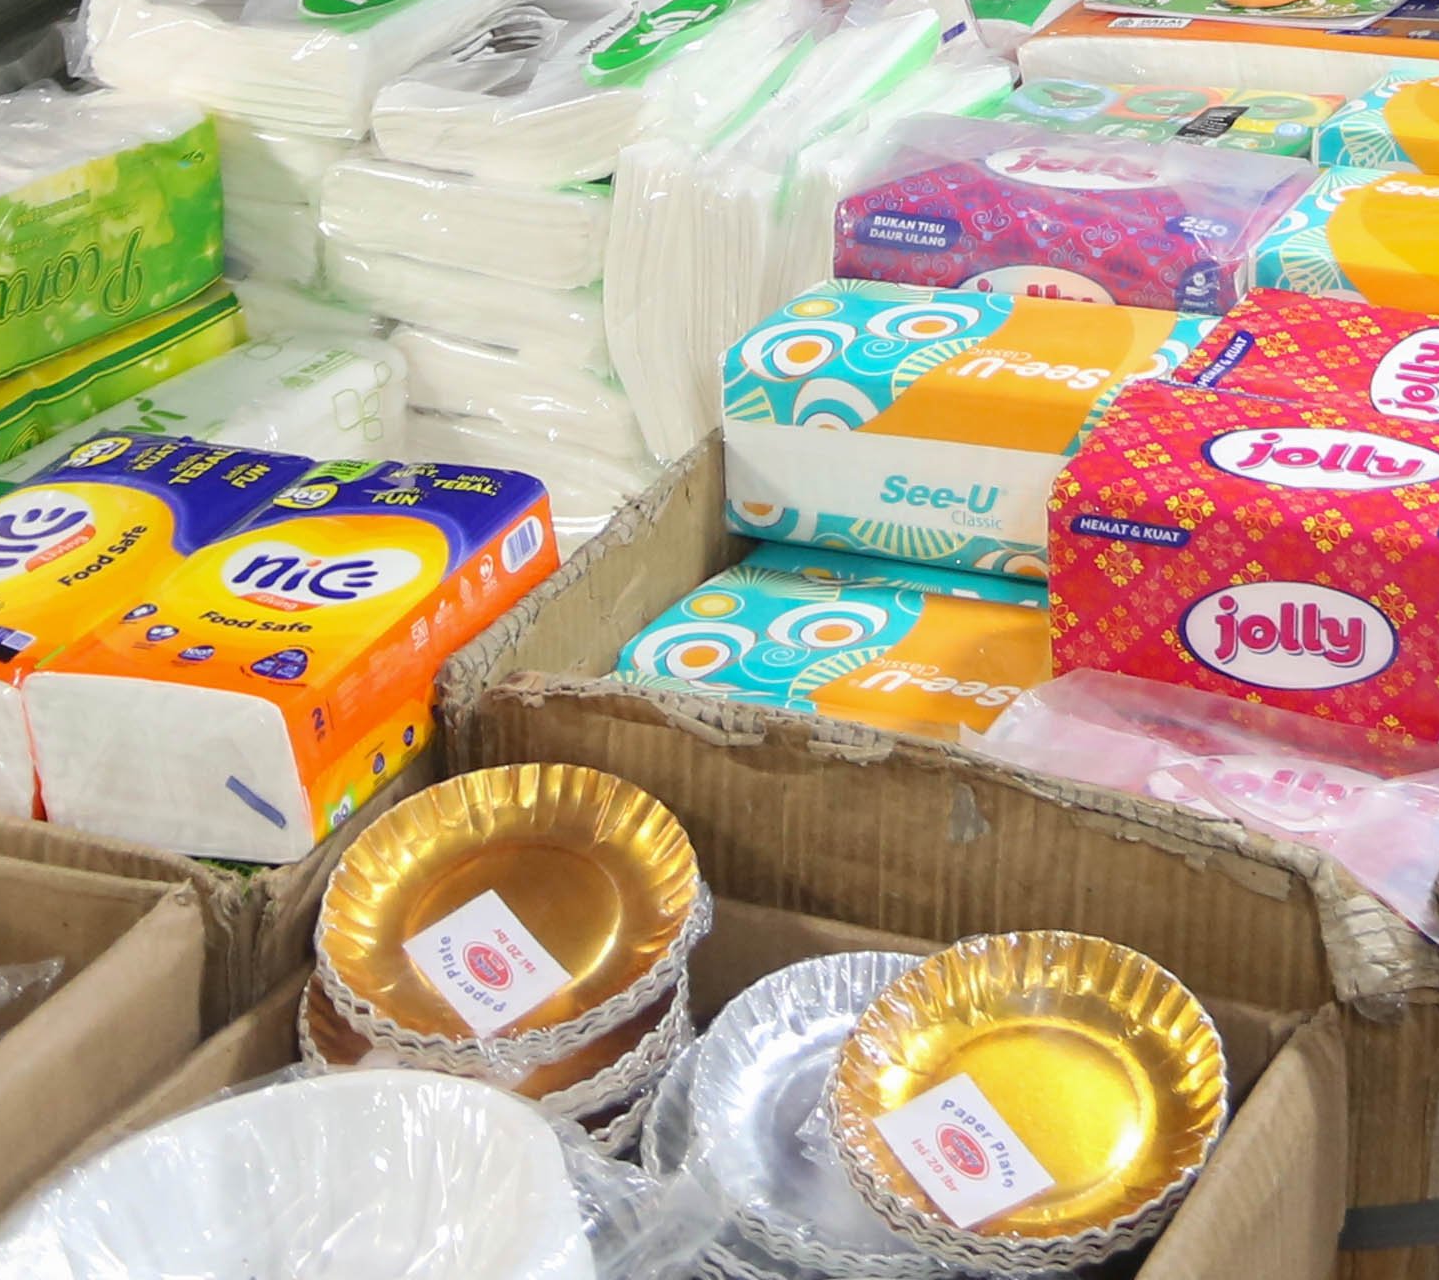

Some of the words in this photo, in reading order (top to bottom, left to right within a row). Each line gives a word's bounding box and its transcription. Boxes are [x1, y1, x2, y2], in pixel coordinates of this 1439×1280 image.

[869, 227, 905, 243] DAUR
[904, 231, 947, 248] ULANG
[873, 215, 916, 232] BUKAN
[916, 220, 946, 234] TISU
[959, 356, 1110, 390] See-U
[1235, 432, 1426, 481] jolly
[230, 463, 272, 490] FUN
[370, 491, 421, 507] FUN
[879, 474, 1000, 515] See-U
[951, 509, 1003, 531] Classic
[1079, 518, 1129, 535] HEMAT
[1129, 525, 1142, 538] &
[1142, 526, 1181, 543] KUAT
[58, 553, 113, 589] Food
[108, 522, 149, 568] Safe
[199, 610, 251, 631] Food
[255, 617, 313, 634] Safe
[1213, 594, 1367, 668] jolly
[860, 669, 1024, 709] See-U
[437, 934, 461, 980] Plate
[506, 943, 524, 960] 20
[457, 980, 507, 1013] Paper
[940, 1098, 994, 1139] Paper
[926, 1156, 945, 1175] 20
